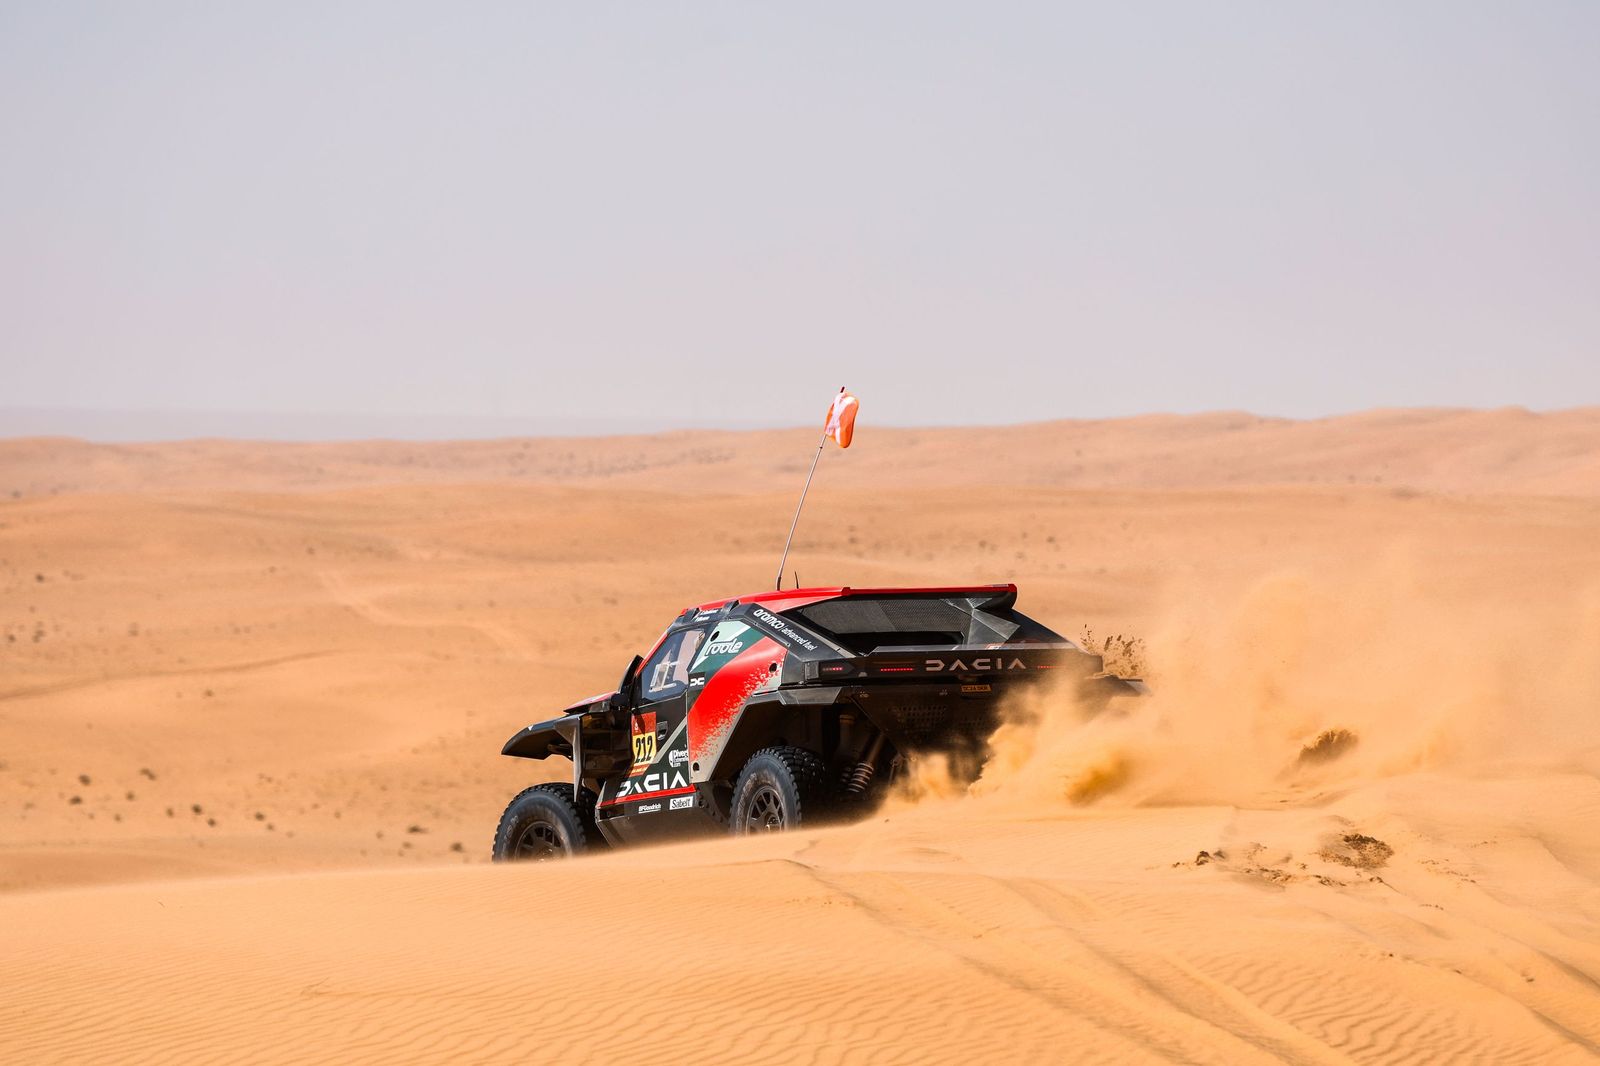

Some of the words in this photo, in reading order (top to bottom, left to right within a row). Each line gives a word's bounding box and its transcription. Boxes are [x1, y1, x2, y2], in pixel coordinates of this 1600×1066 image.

[753, 609, 784, 629] aramco
[781, 628, 808, 645] advanced
[802, 641, 818, 651] fuel
[926, 658, 1026, 671] DACIA
[634, 735, 653, 763] 212
[616, 770, 687, 797] DACIA
